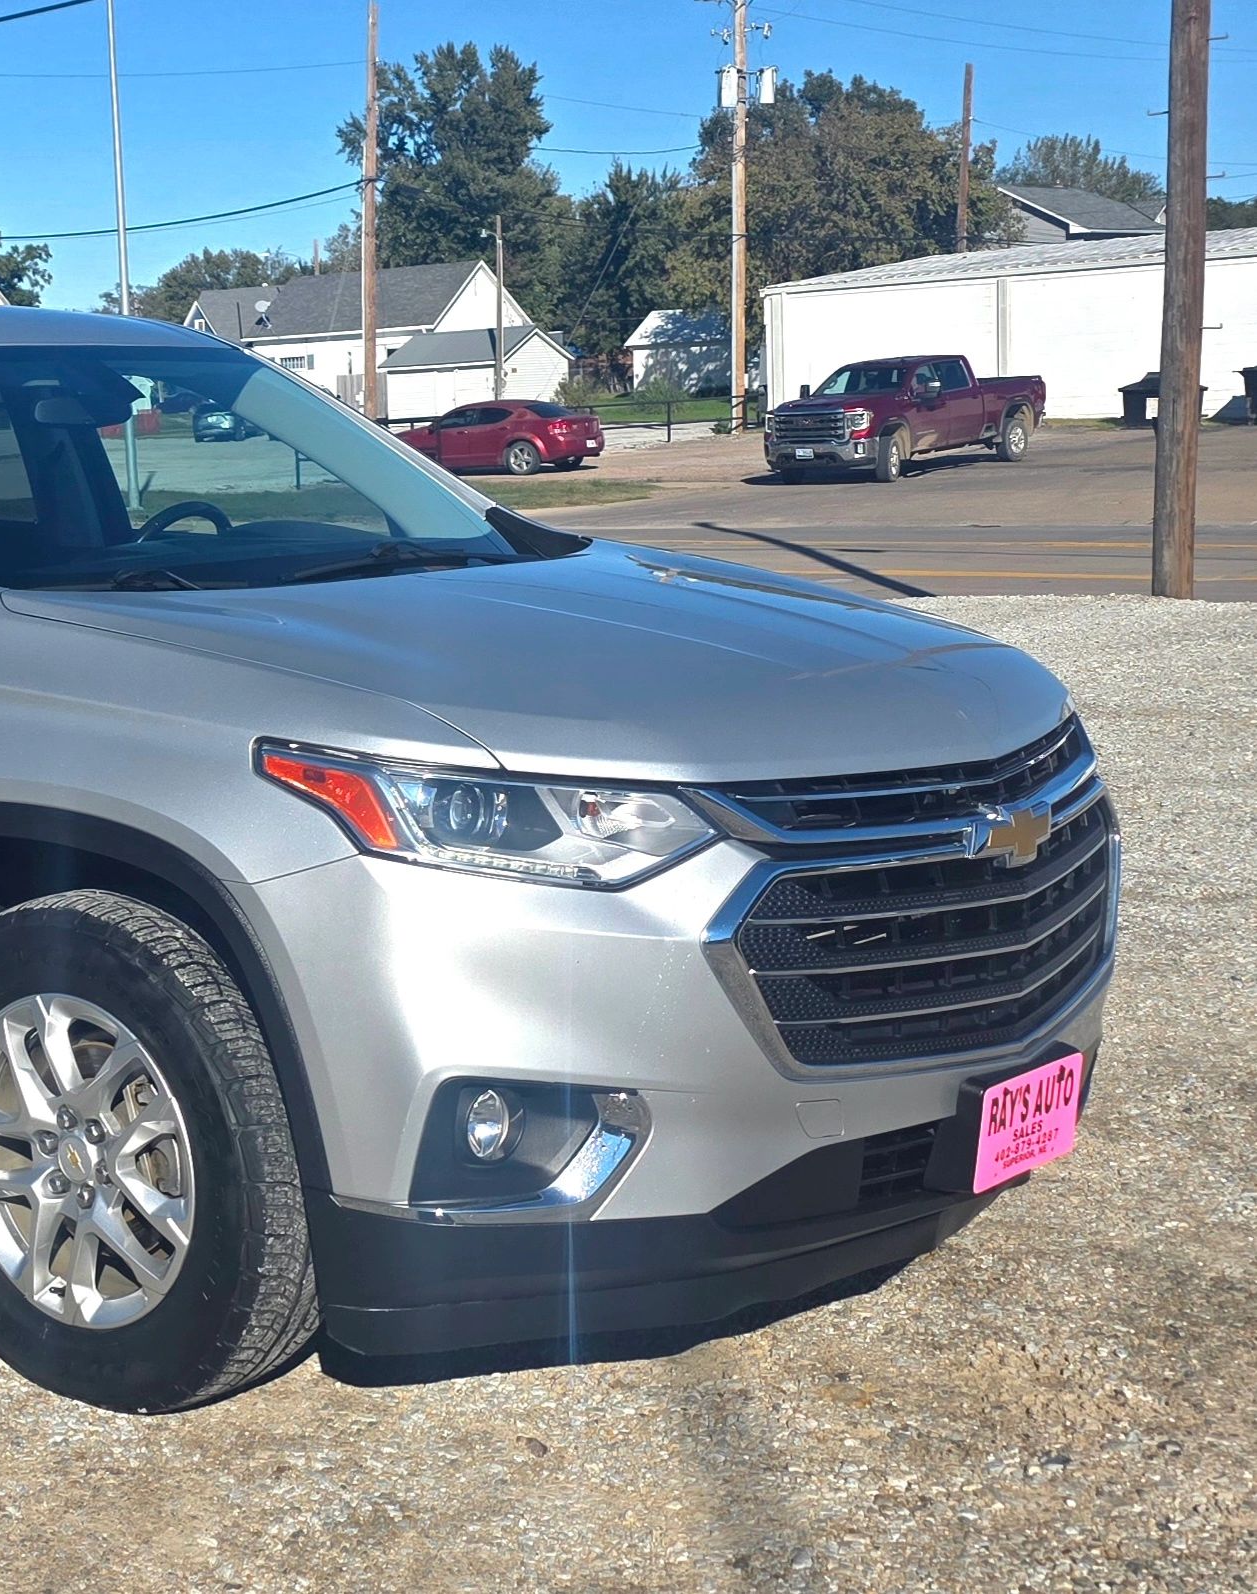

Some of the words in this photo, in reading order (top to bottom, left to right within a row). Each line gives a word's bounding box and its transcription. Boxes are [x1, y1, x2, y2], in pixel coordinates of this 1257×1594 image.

[988, 1084, 1031, 1137] RAY'S
[1033, 1068, 1075, 1118] AUTO
[1012, 1120, 1044, 1142] SALES
